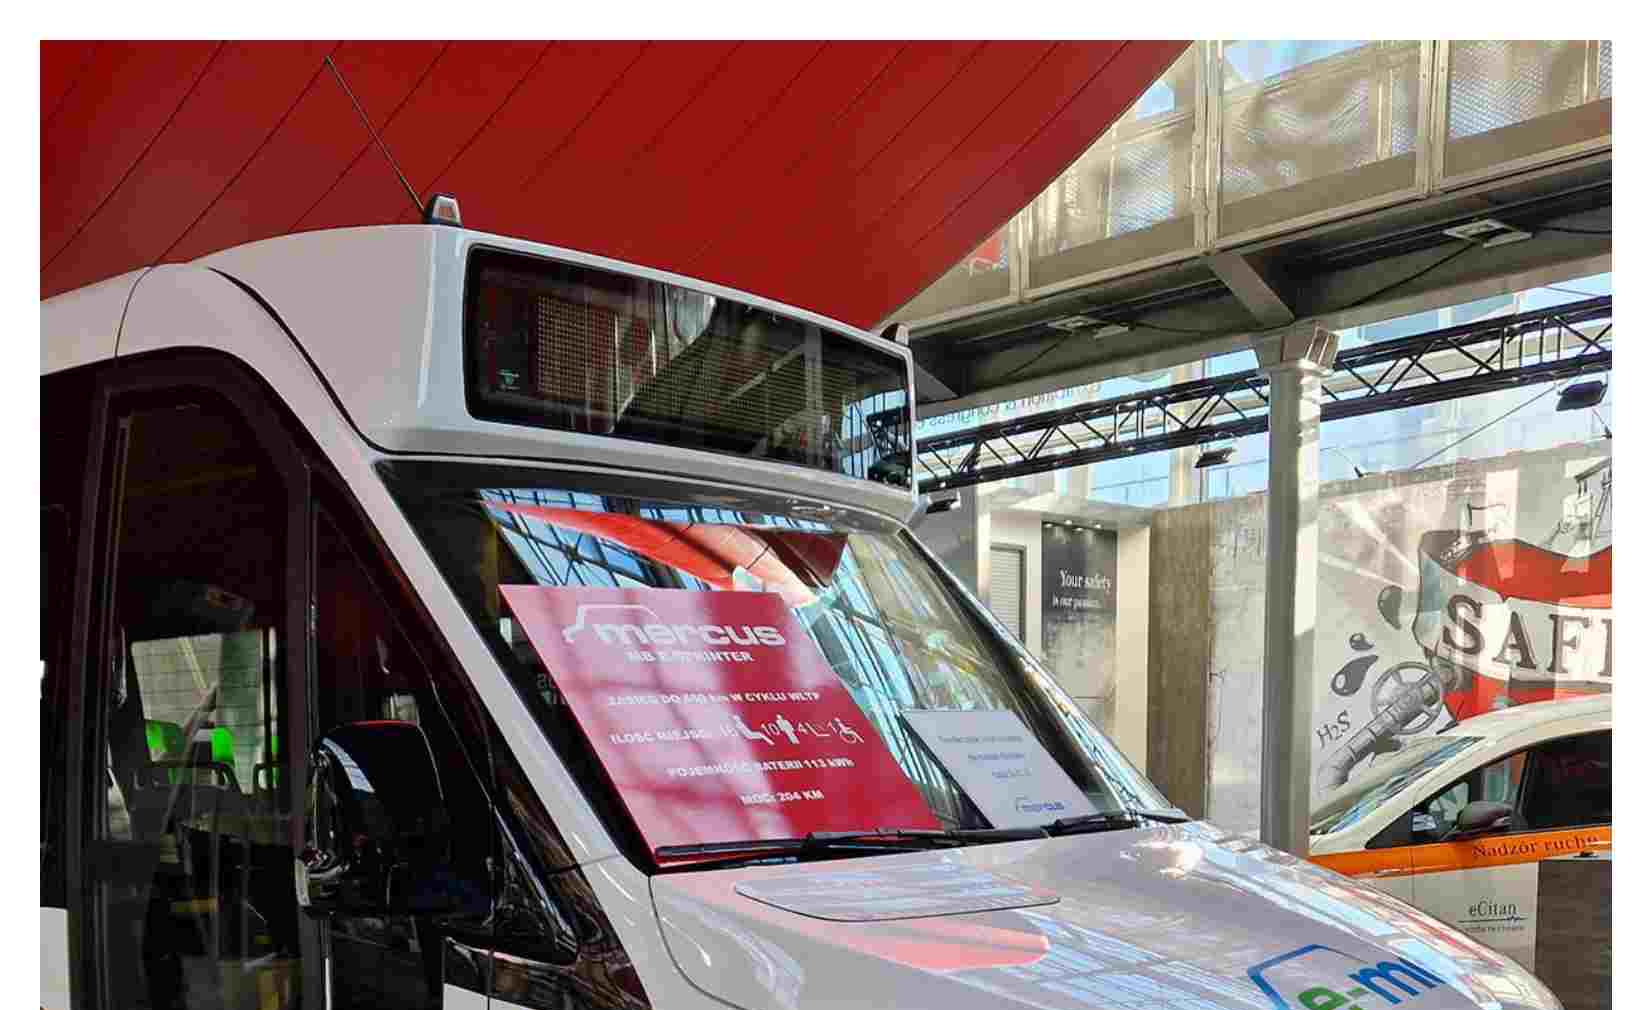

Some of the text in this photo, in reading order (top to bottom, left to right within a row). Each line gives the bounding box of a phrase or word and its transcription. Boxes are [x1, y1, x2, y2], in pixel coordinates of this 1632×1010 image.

[1059, 569, 1083, 588] Your
[597, 622, 787, 648] mercus
[746, 691, 786, 702] CYKLU
[803, 789, 825, 800] KM
[1468, 898, 1518, 917] eCitan
